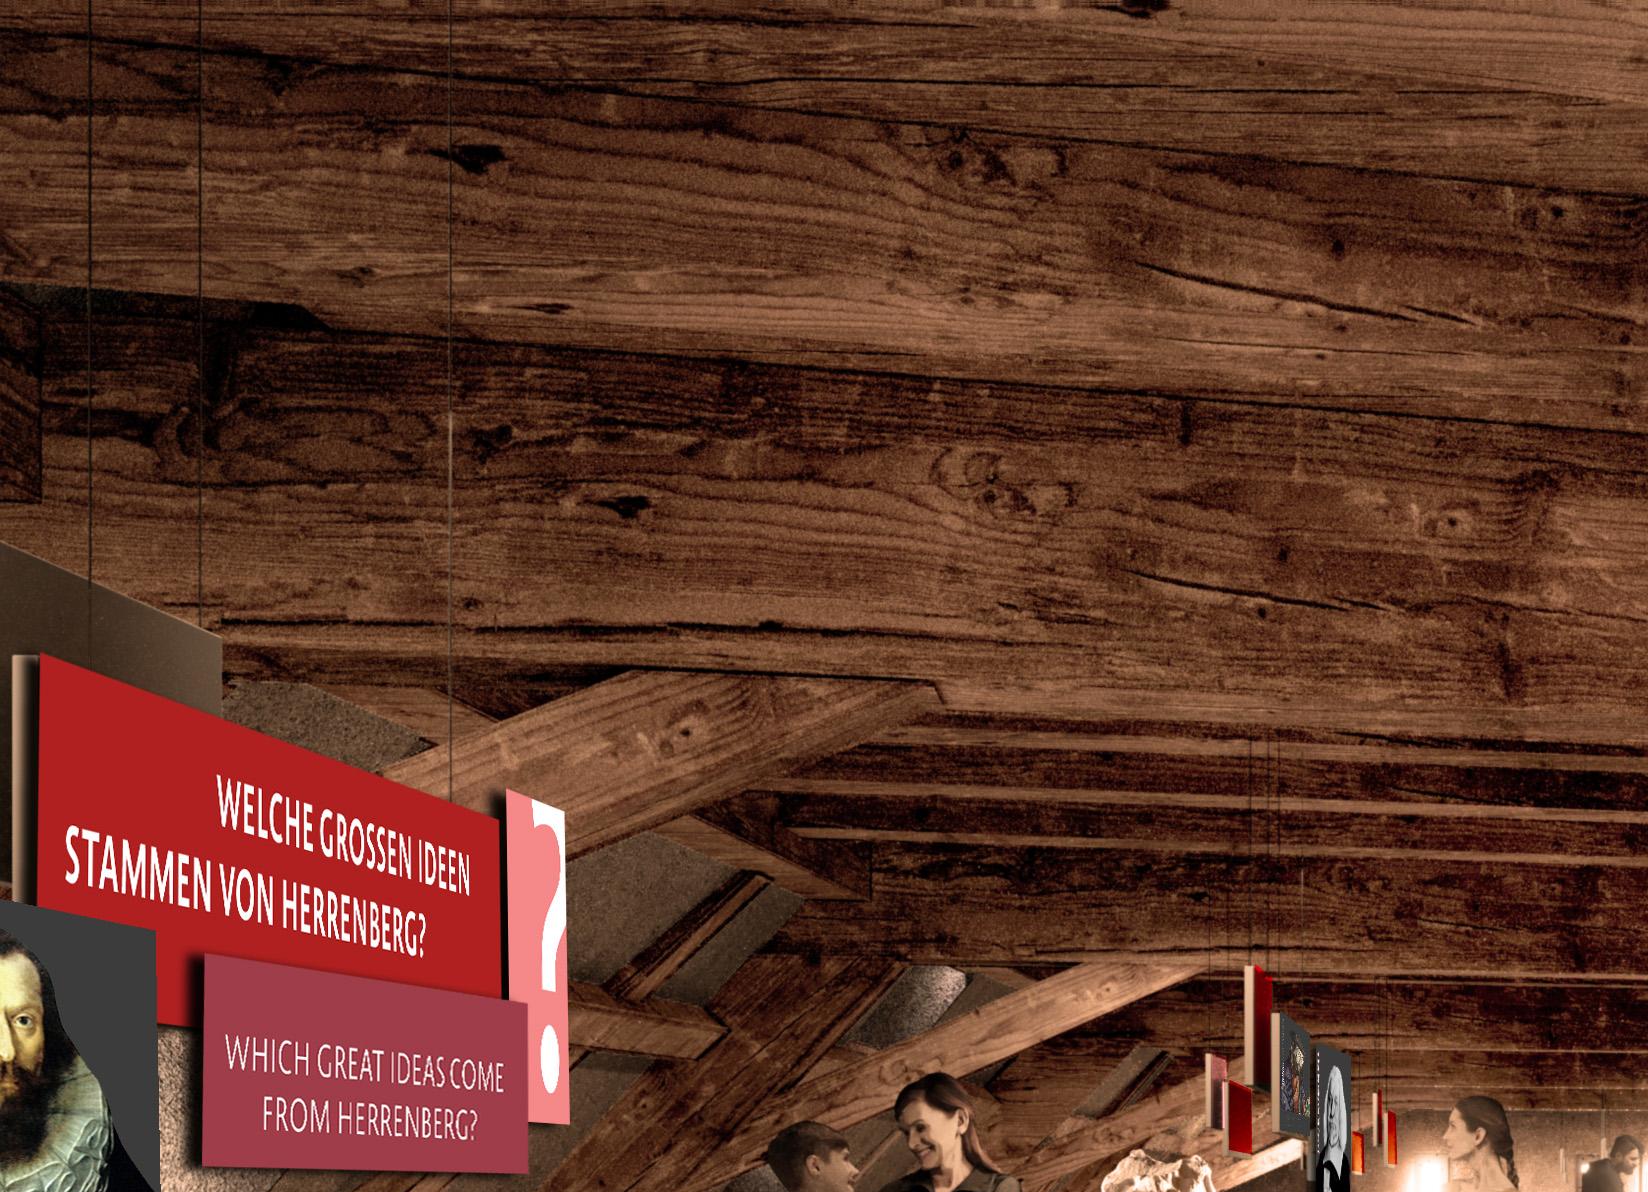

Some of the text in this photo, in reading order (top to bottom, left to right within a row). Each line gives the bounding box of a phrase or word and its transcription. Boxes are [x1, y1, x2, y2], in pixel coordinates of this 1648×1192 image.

[216, 774, 470, 896] WELCHE GROSSEN IDEEN
[64, 825, 426, 958] STAMMEN VON HERRENBERG?
[225, 1034, 504, 1093] WHICH GREAT IDEAS COME
[263, 1096, 478, 1140] FROM HERRENBERG?
